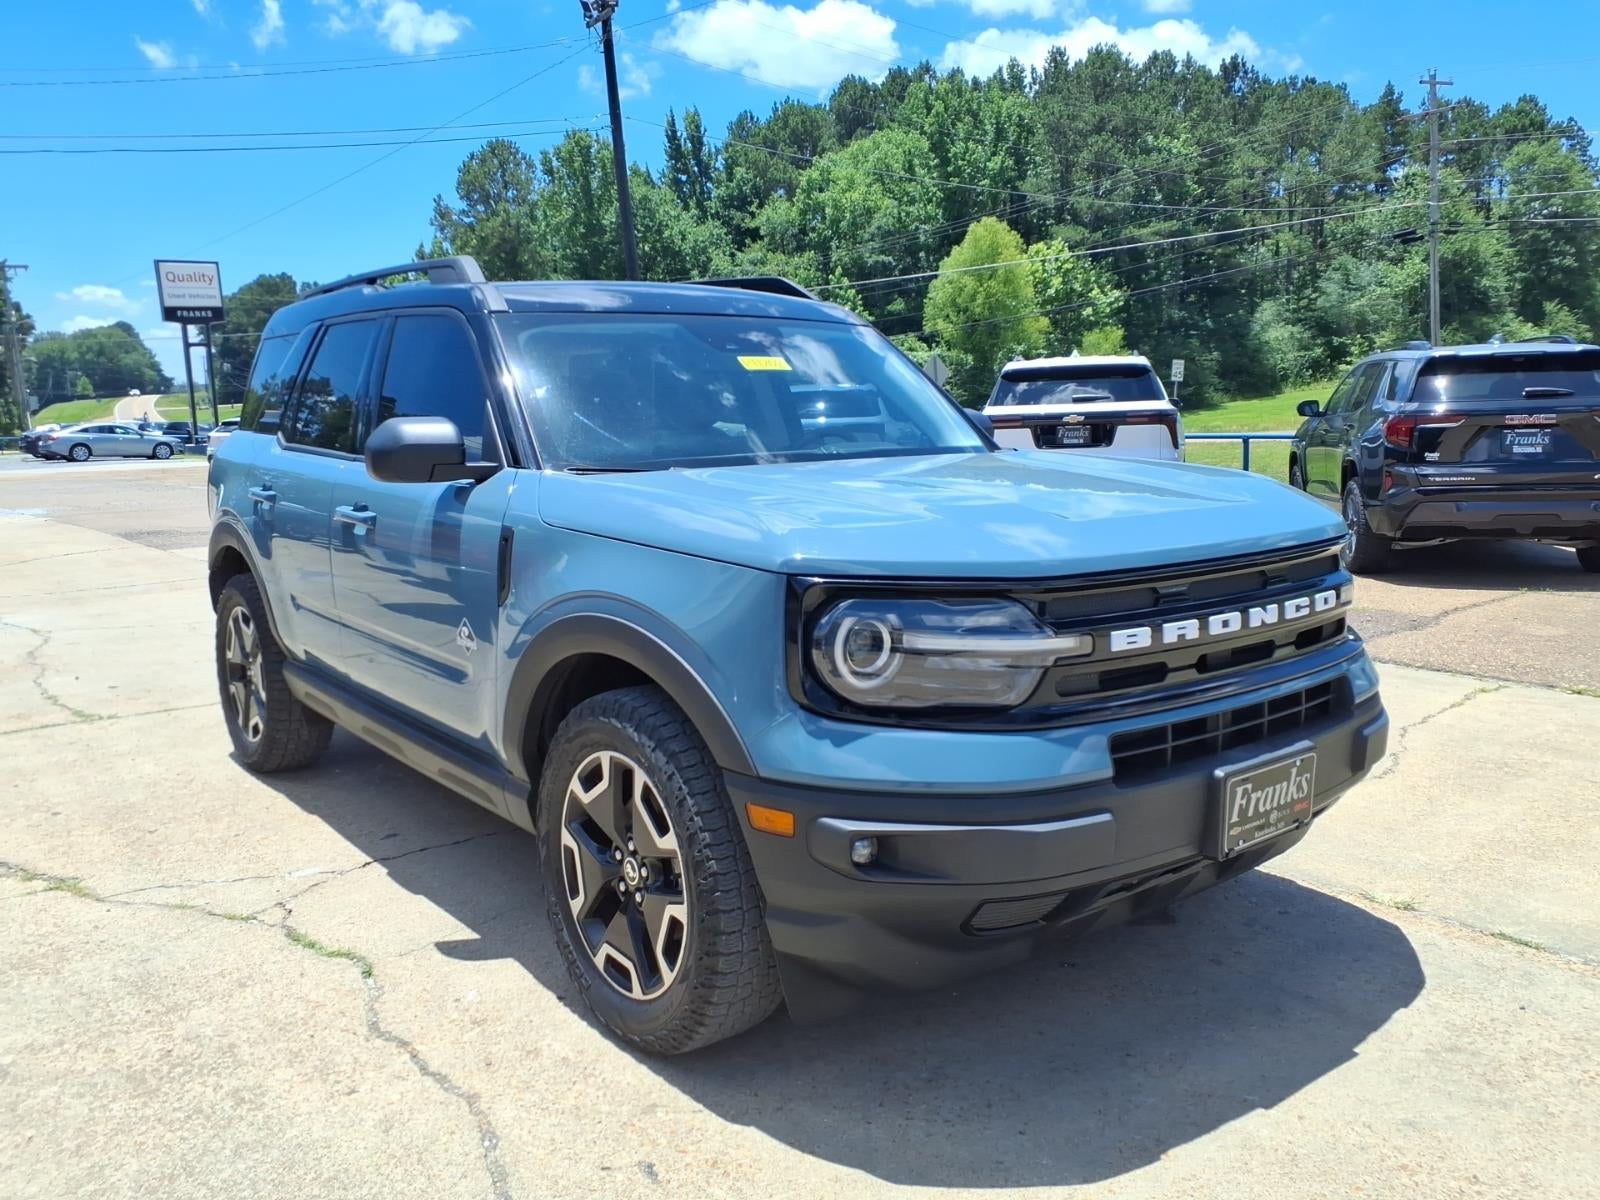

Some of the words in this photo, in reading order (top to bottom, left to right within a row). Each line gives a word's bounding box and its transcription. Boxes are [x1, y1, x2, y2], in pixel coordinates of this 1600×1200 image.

[165, 271, 214, 286] Quality
[177, 310, 213, 318] FRANKS
[1505, 414, 1557, 424] GMC
[1058, 427, 1089, 438] Franks
[1505, 432, 1550, 445] Franks
[1110, 589, 1337, 652] BRONCO
[1229, 766, 1311, 824] Franks
